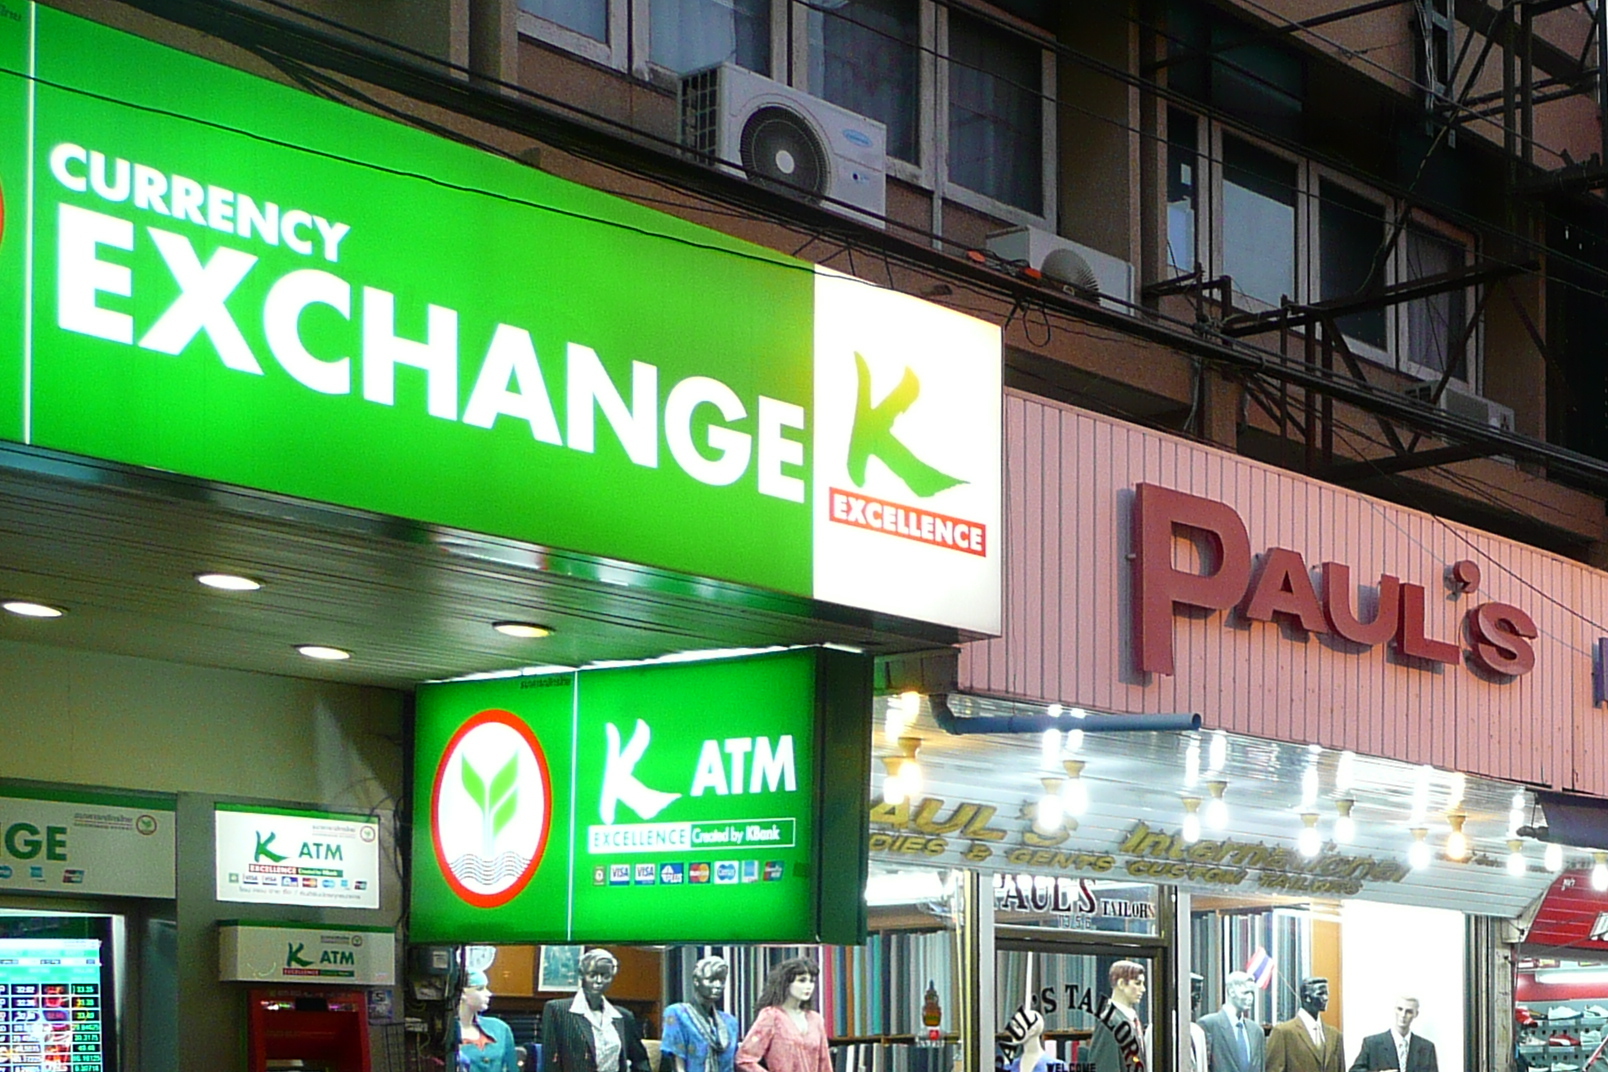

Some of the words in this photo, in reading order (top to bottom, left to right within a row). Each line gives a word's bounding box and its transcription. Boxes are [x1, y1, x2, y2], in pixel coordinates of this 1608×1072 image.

[49, 143, 351, 262] CURRENCY
[57, 203, 805, 503] EXCHANGE
[833, 495, 984, 552] EXCELLENCE
[1133, 482, 1538, 677] PAUL'S
[599, 718, 682, 826] K
[690, 734, 797, 797] ATM
[0, 822, 68, 862] GE
[298, 842, 343, 861] ATM
[593, 828, 687, 848] EXCELLENCE
[731, 827, 744, 844] by
[745, 824, 781, 842] KBank
[250, 865, 297, 875] EXCELLENCE
[613, 866, 629, 878] VISA
[637, 865, 655, 877] VISA
[1007, 847, 1116, 873] GENTS
[1127, 859, 1248, 885] CUSTOM
[320, 951, 354, 965] ATM
